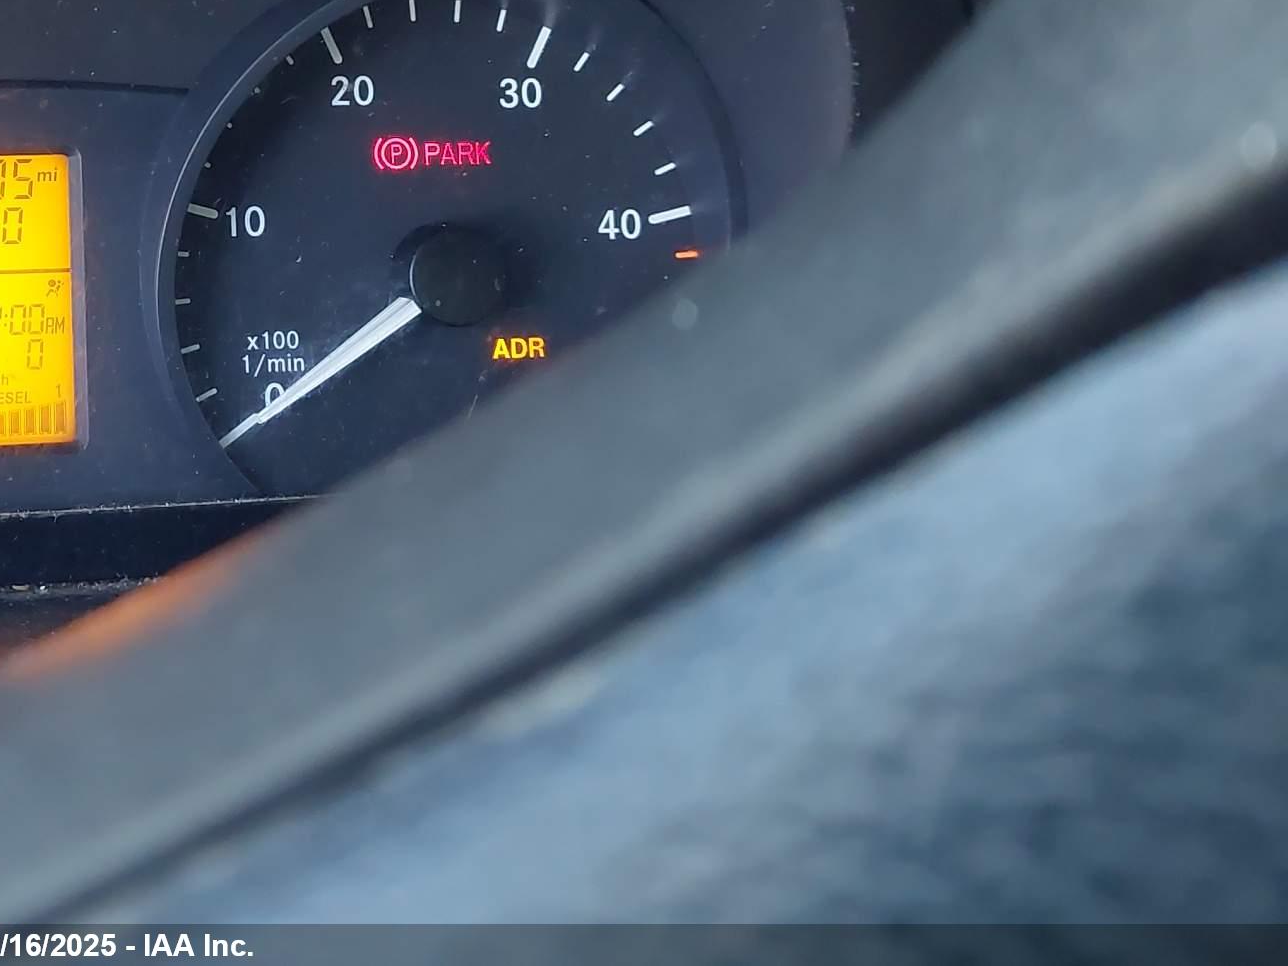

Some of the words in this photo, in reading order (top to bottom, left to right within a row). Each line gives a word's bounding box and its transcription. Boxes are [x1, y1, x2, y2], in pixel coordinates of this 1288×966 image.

[330, 76, 374, 106] 20
[499, 78, 542, 108] 30
[423, 142, 490, 165] PARK
[226, 206, 265, 237] 10
[598, 210, 642, 240] 40
[26, 339, 44, 370] 0
[247, 330, 299, 350] x100
[492, 337, 545, 359] ADR
[241, 353, 305, 374] 1/min
